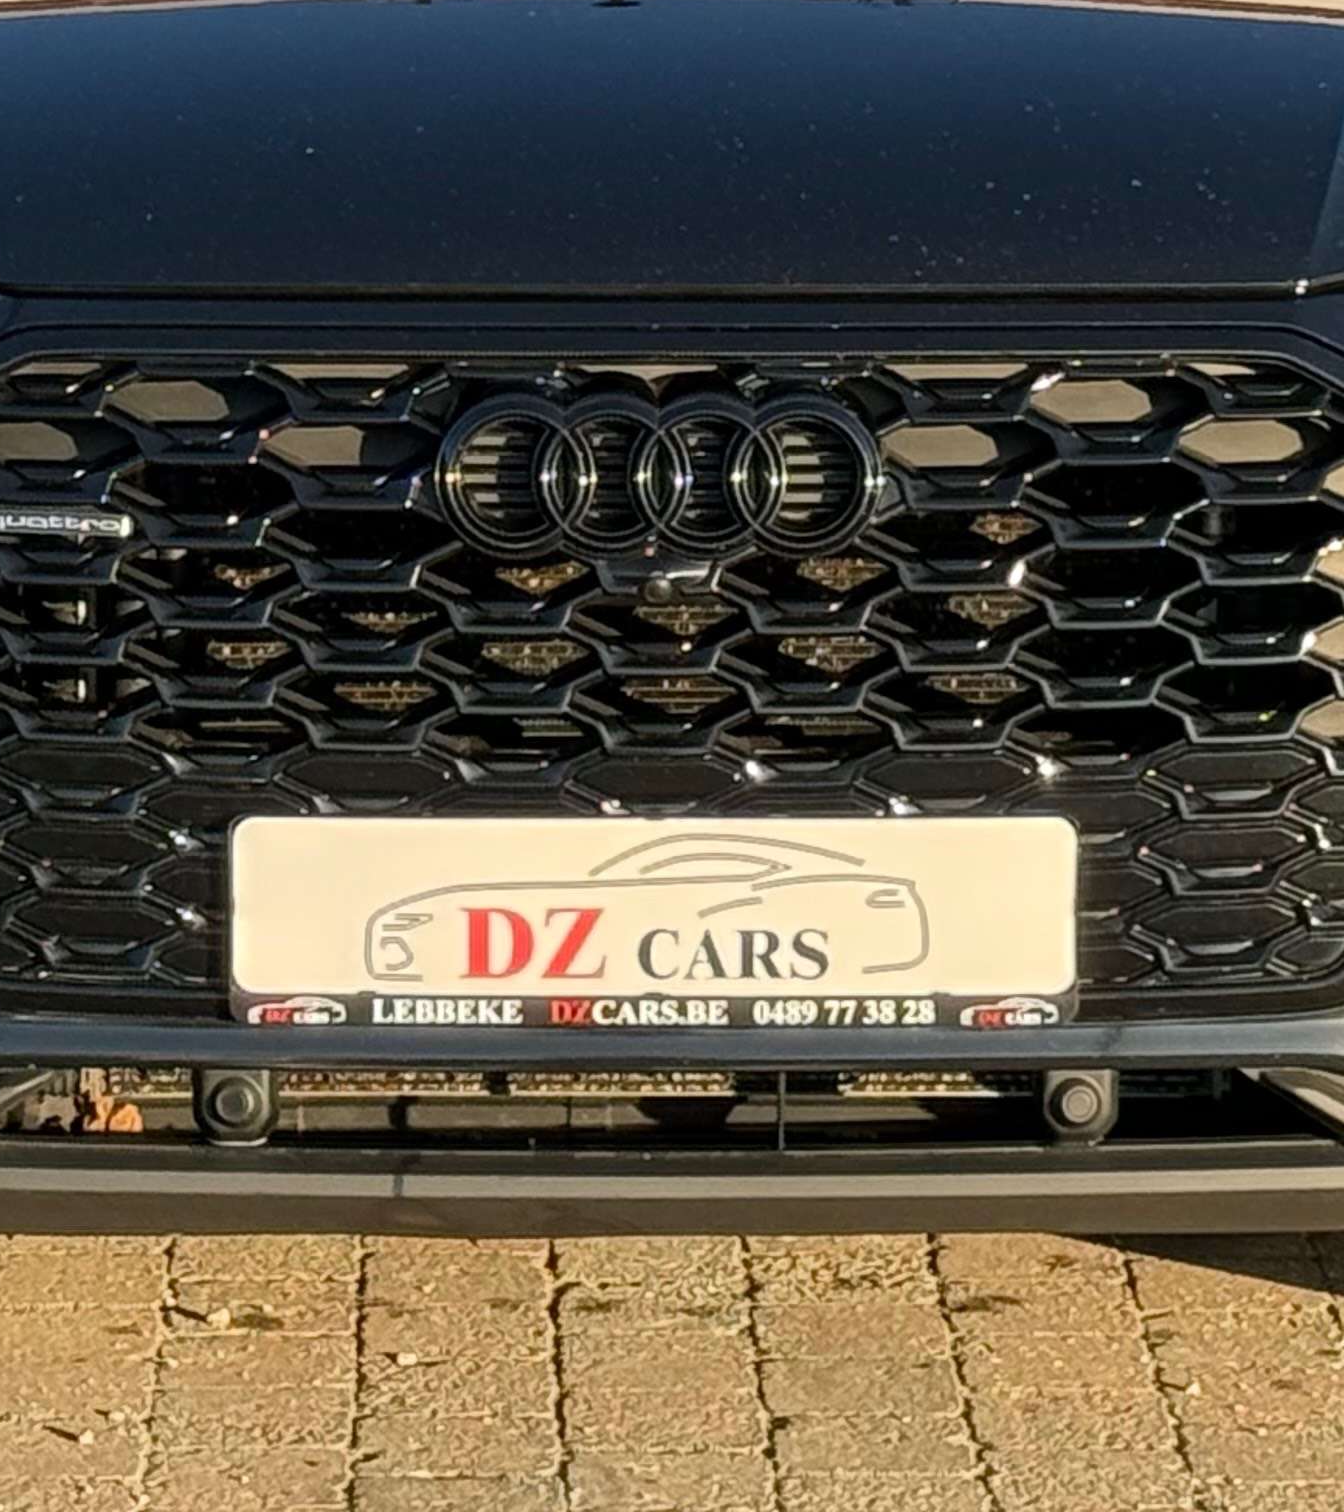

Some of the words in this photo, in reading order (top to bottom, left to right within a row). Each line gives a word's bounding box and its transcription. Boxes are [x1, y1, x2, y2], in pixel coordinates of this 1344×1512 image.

[459, 907, 607, 980] DZ
[637, 928, 829, 981] CARS
[372, 998, 523, 1024] LEBBEKE
[550, 997, 729, 1026] DZCARS.BE
[753, 999, 817, 1025] 0489
[824, 999, 856, 1025] 77
[862, 999, 896, 1025] 38
[901, 999, 935, 1025] 28
